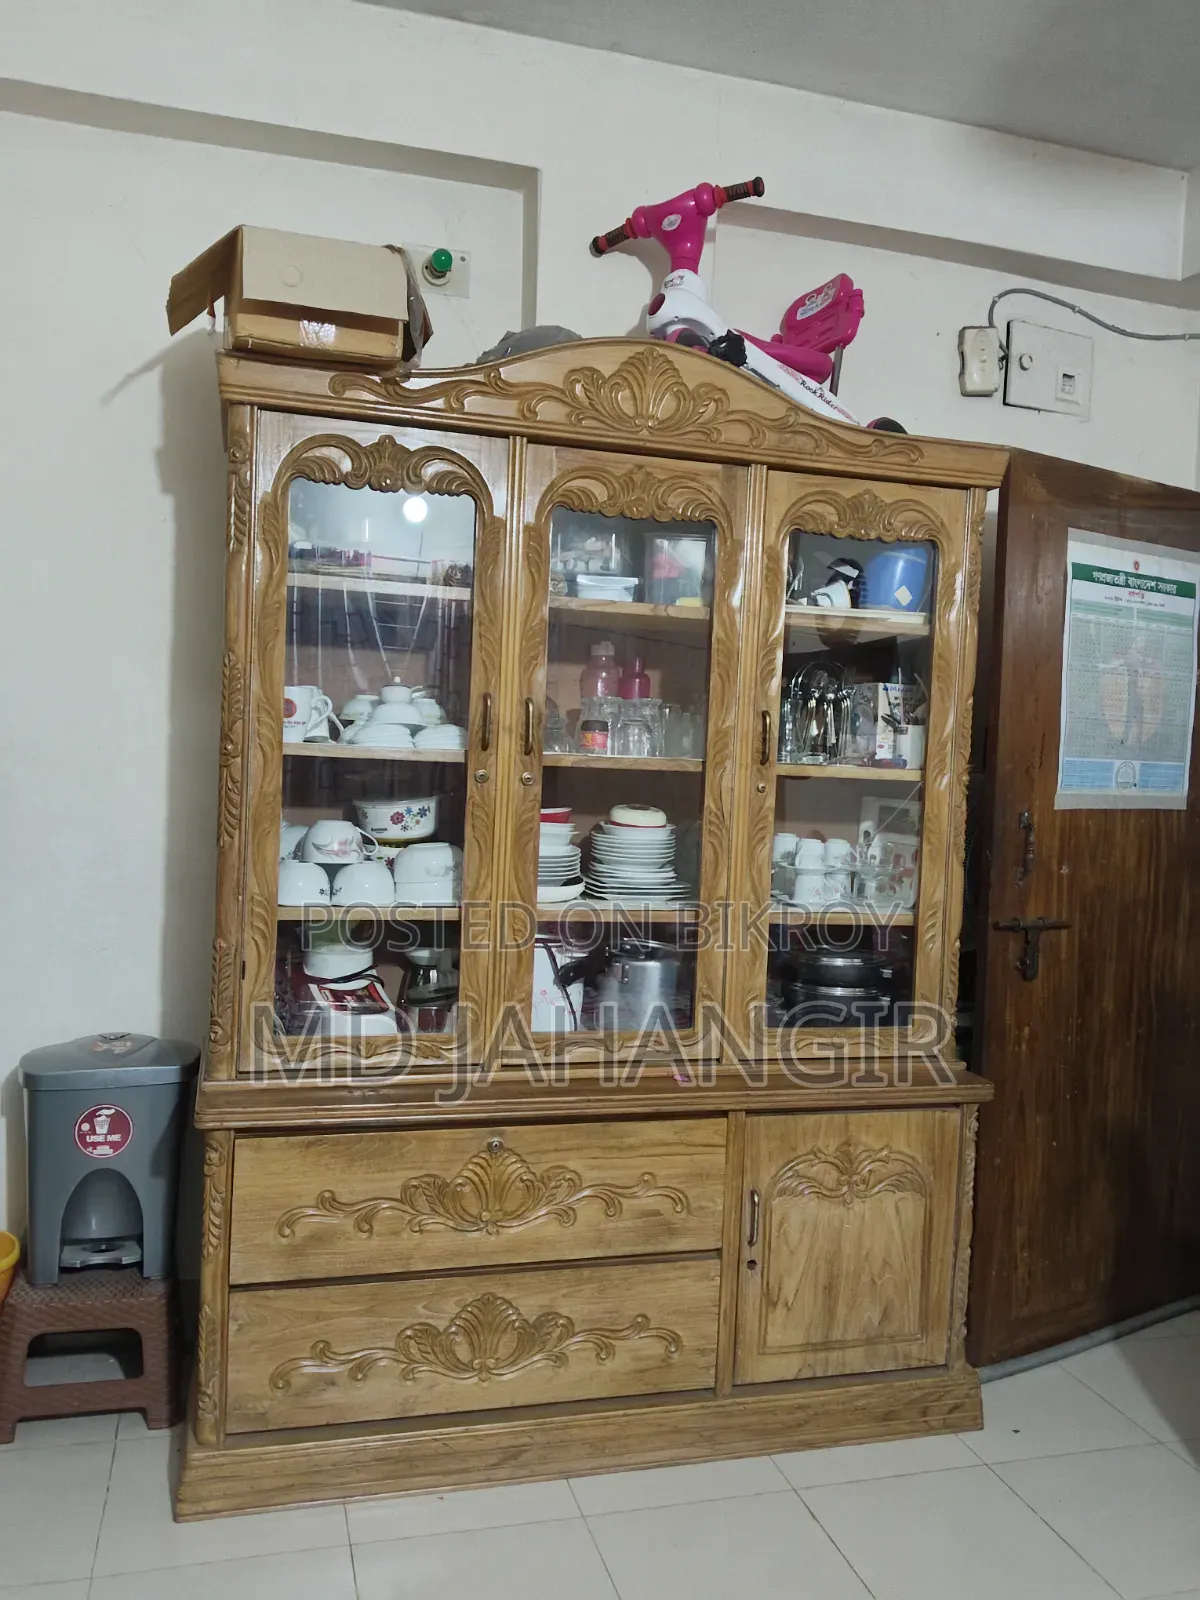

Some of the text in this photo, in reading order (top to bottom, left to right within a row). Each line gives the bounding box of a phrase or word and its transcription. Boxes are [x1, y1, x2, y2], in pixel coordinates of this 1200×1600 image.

[799, 378, 818, 397] Rock
[1127, 576, 1156, 590] বাংলাদেশ
[107, 1134, 121, 1142] ME
